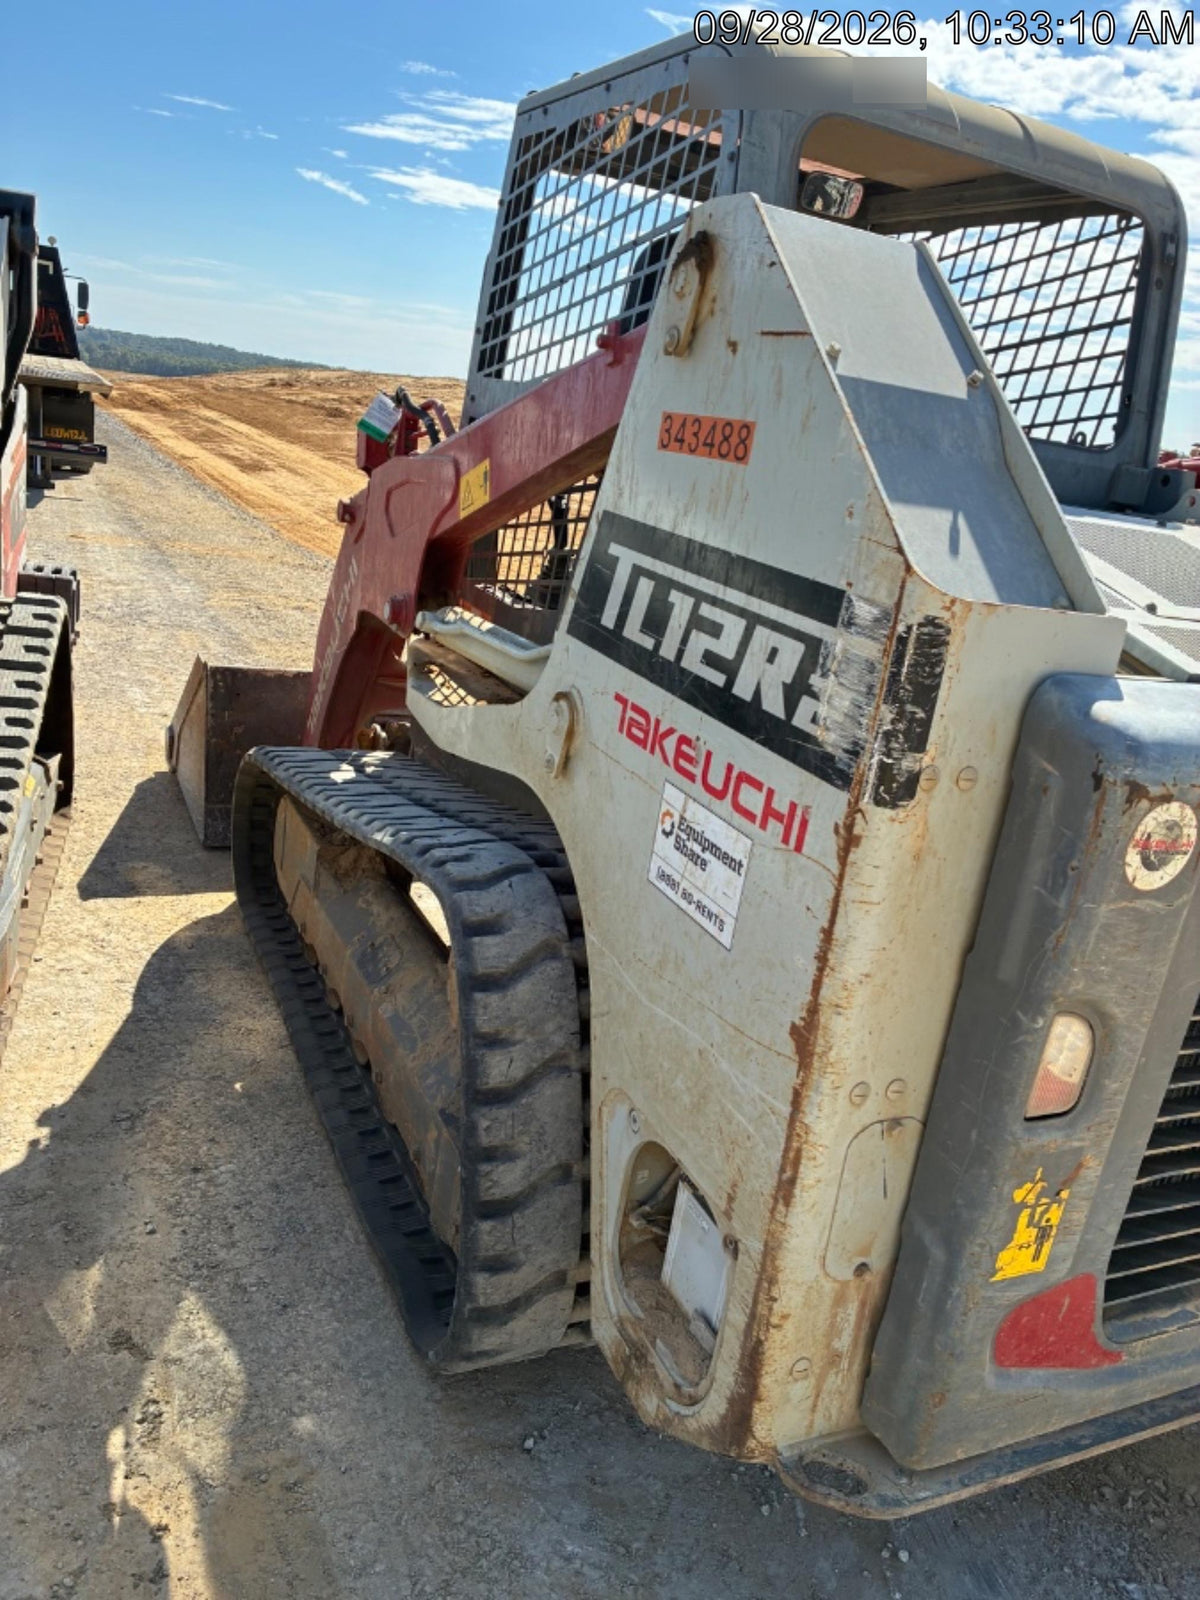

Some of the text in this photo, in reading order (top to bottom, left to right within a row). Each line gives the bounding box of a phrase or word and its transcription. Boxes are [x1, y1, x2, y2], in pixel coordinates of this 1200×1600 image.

[661, 415, 751, 461] 343488
[673, 835, 708, 872] Share
[677, 814, 744, 877] Equipment
